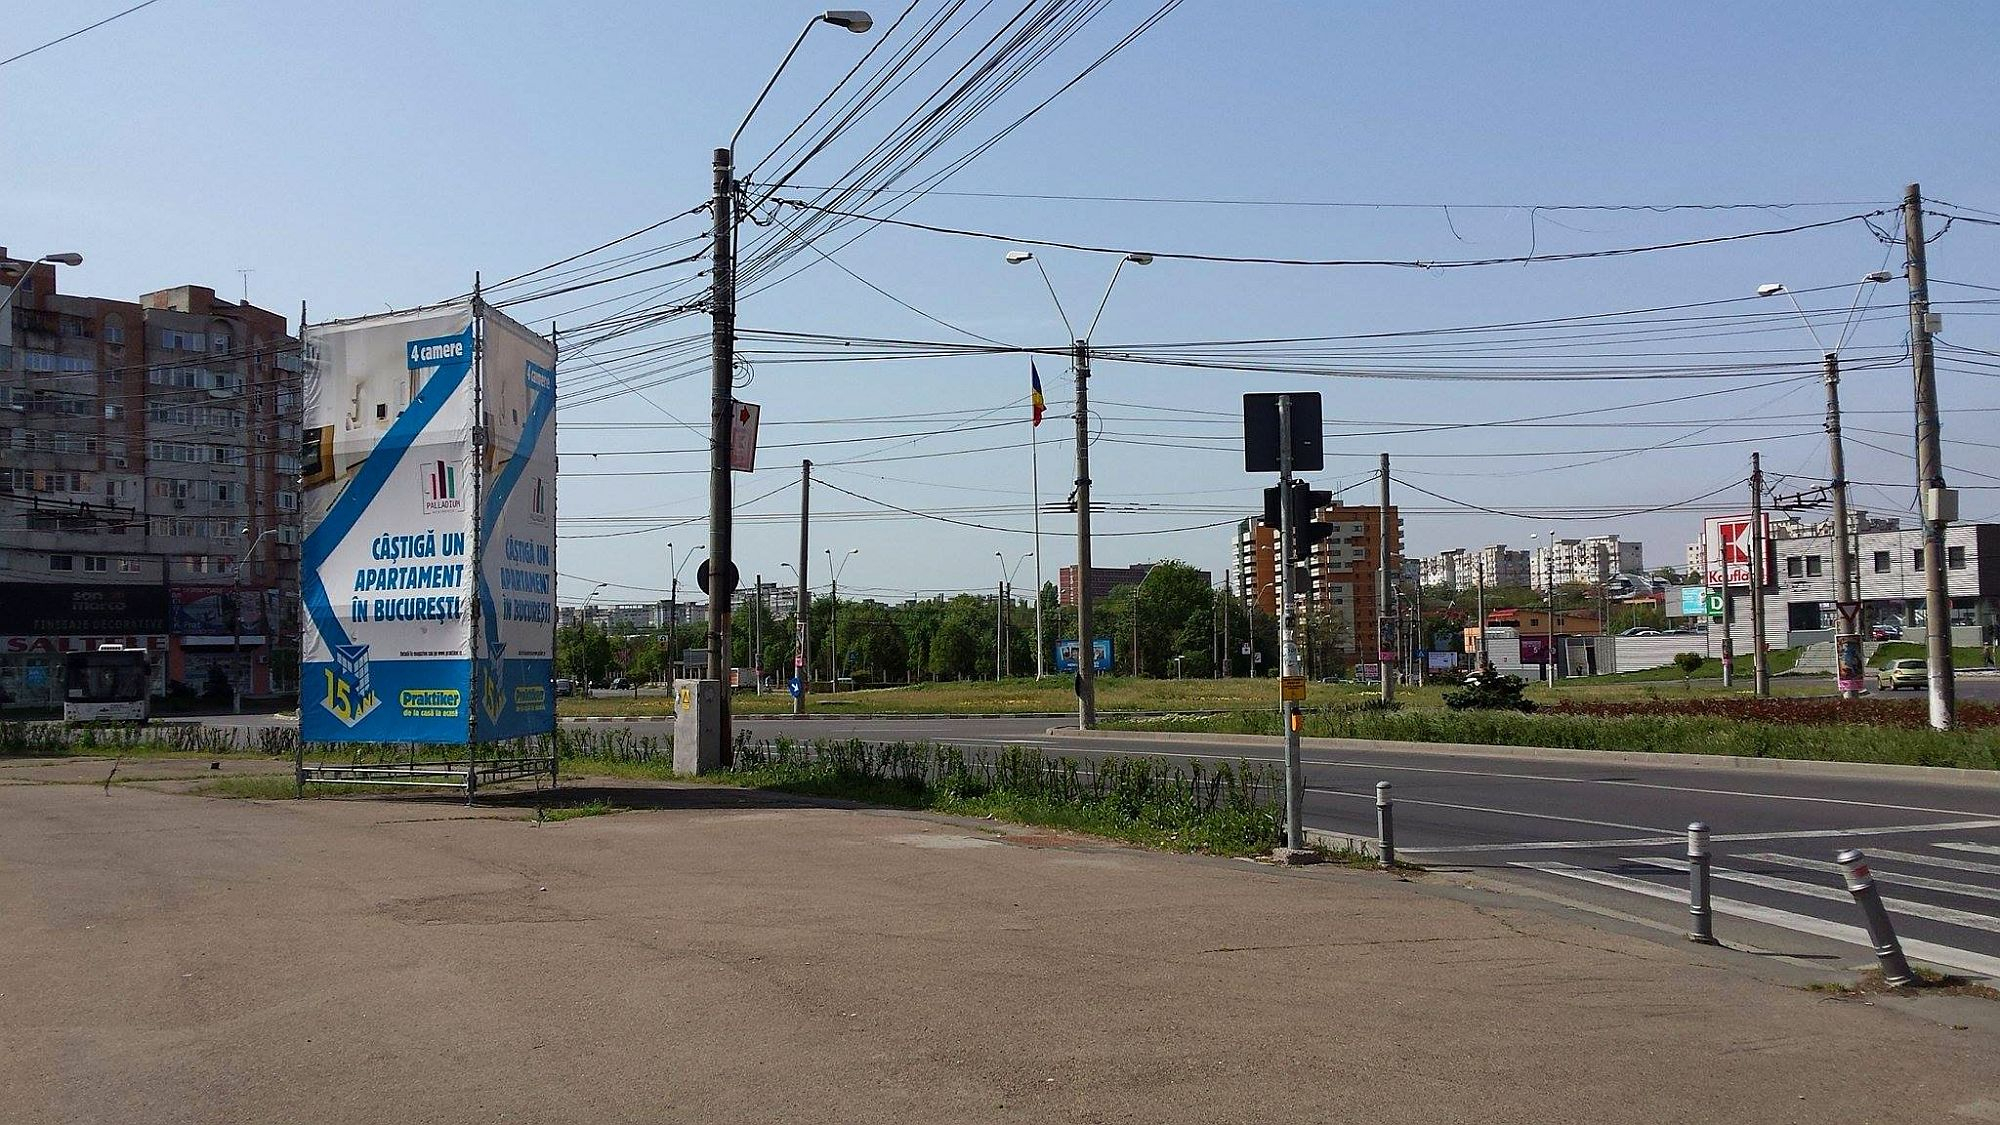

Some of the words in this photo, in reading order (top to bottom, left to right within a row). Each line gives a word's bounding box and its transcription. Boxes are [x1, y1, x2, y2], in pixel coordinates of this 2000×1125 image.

[411, 345, 419, 362] 4
[420, 342, 463, 361] camere
[426, 500, 461, 509] PALLADIUM
[442, 533, 465, 557] UN
[536, 544, 549, 567] UN
[354, 565, 463, 592] APARTAMENT
[500, 567, 550, 595] APARTAMENT
[352, 597, 367, 623] ÎN
[324, 667, 352, 719] 15
[354, 690, 375, 720] ANI
[403, 691, 459, 706] Praktiker
